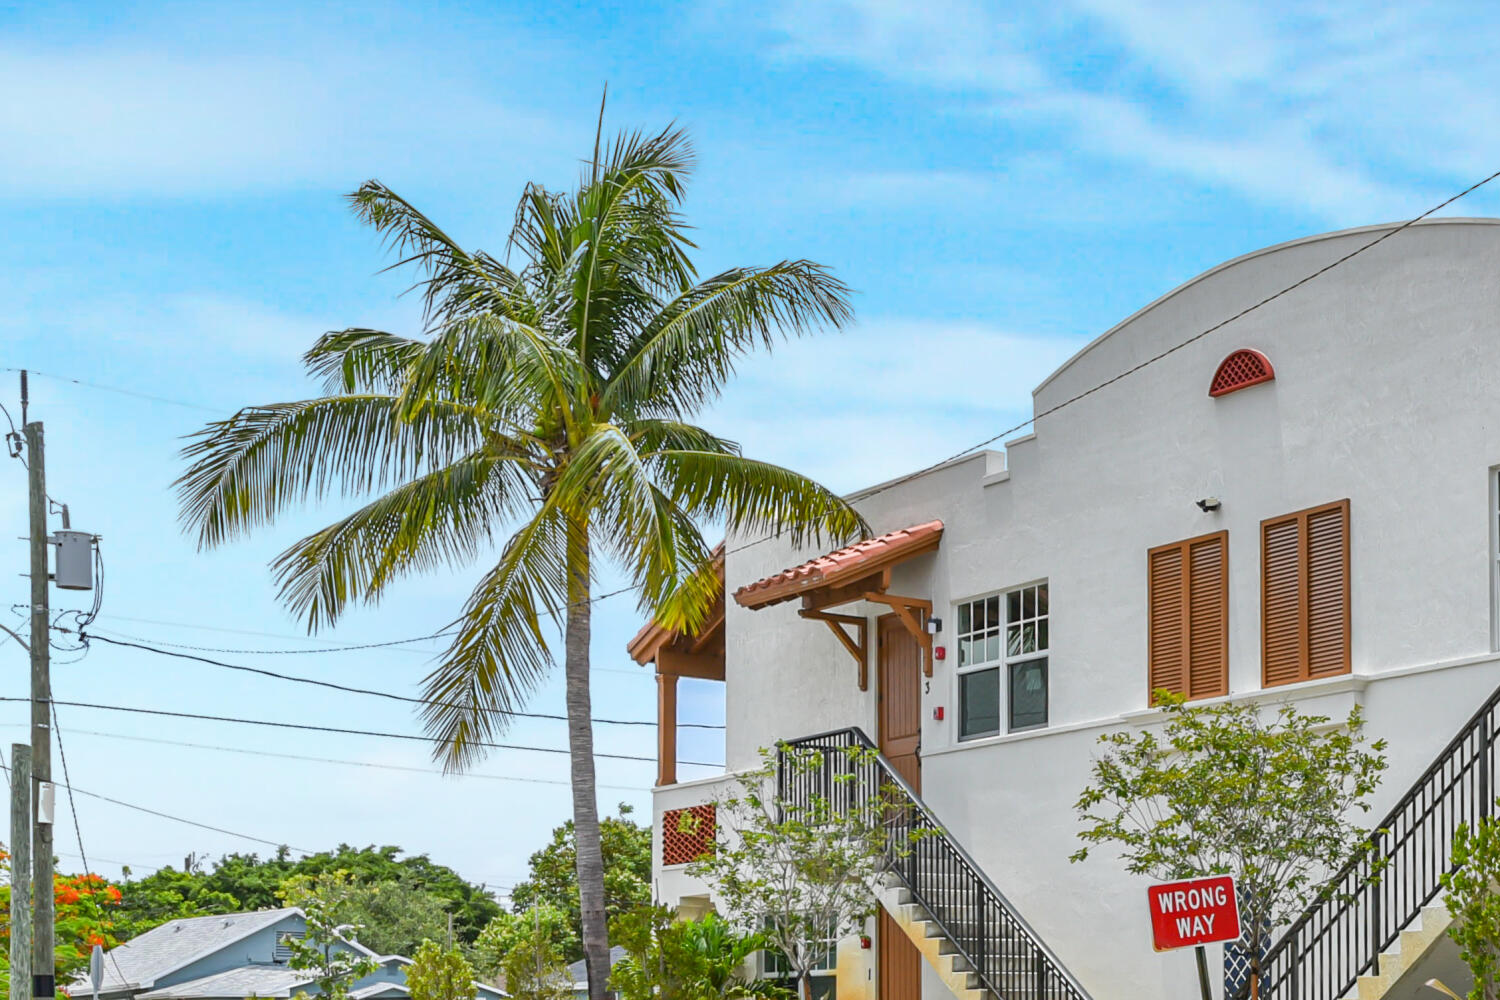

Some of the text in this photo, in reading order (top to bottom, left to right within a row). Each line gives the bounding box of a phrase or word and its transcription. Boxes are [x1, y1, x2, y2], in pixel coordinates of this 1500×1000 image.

[925, 681, 931, 695] 3
[1158, 885, 1227, 914] WRONG
[1176, 913, 1215, 939] WAY
